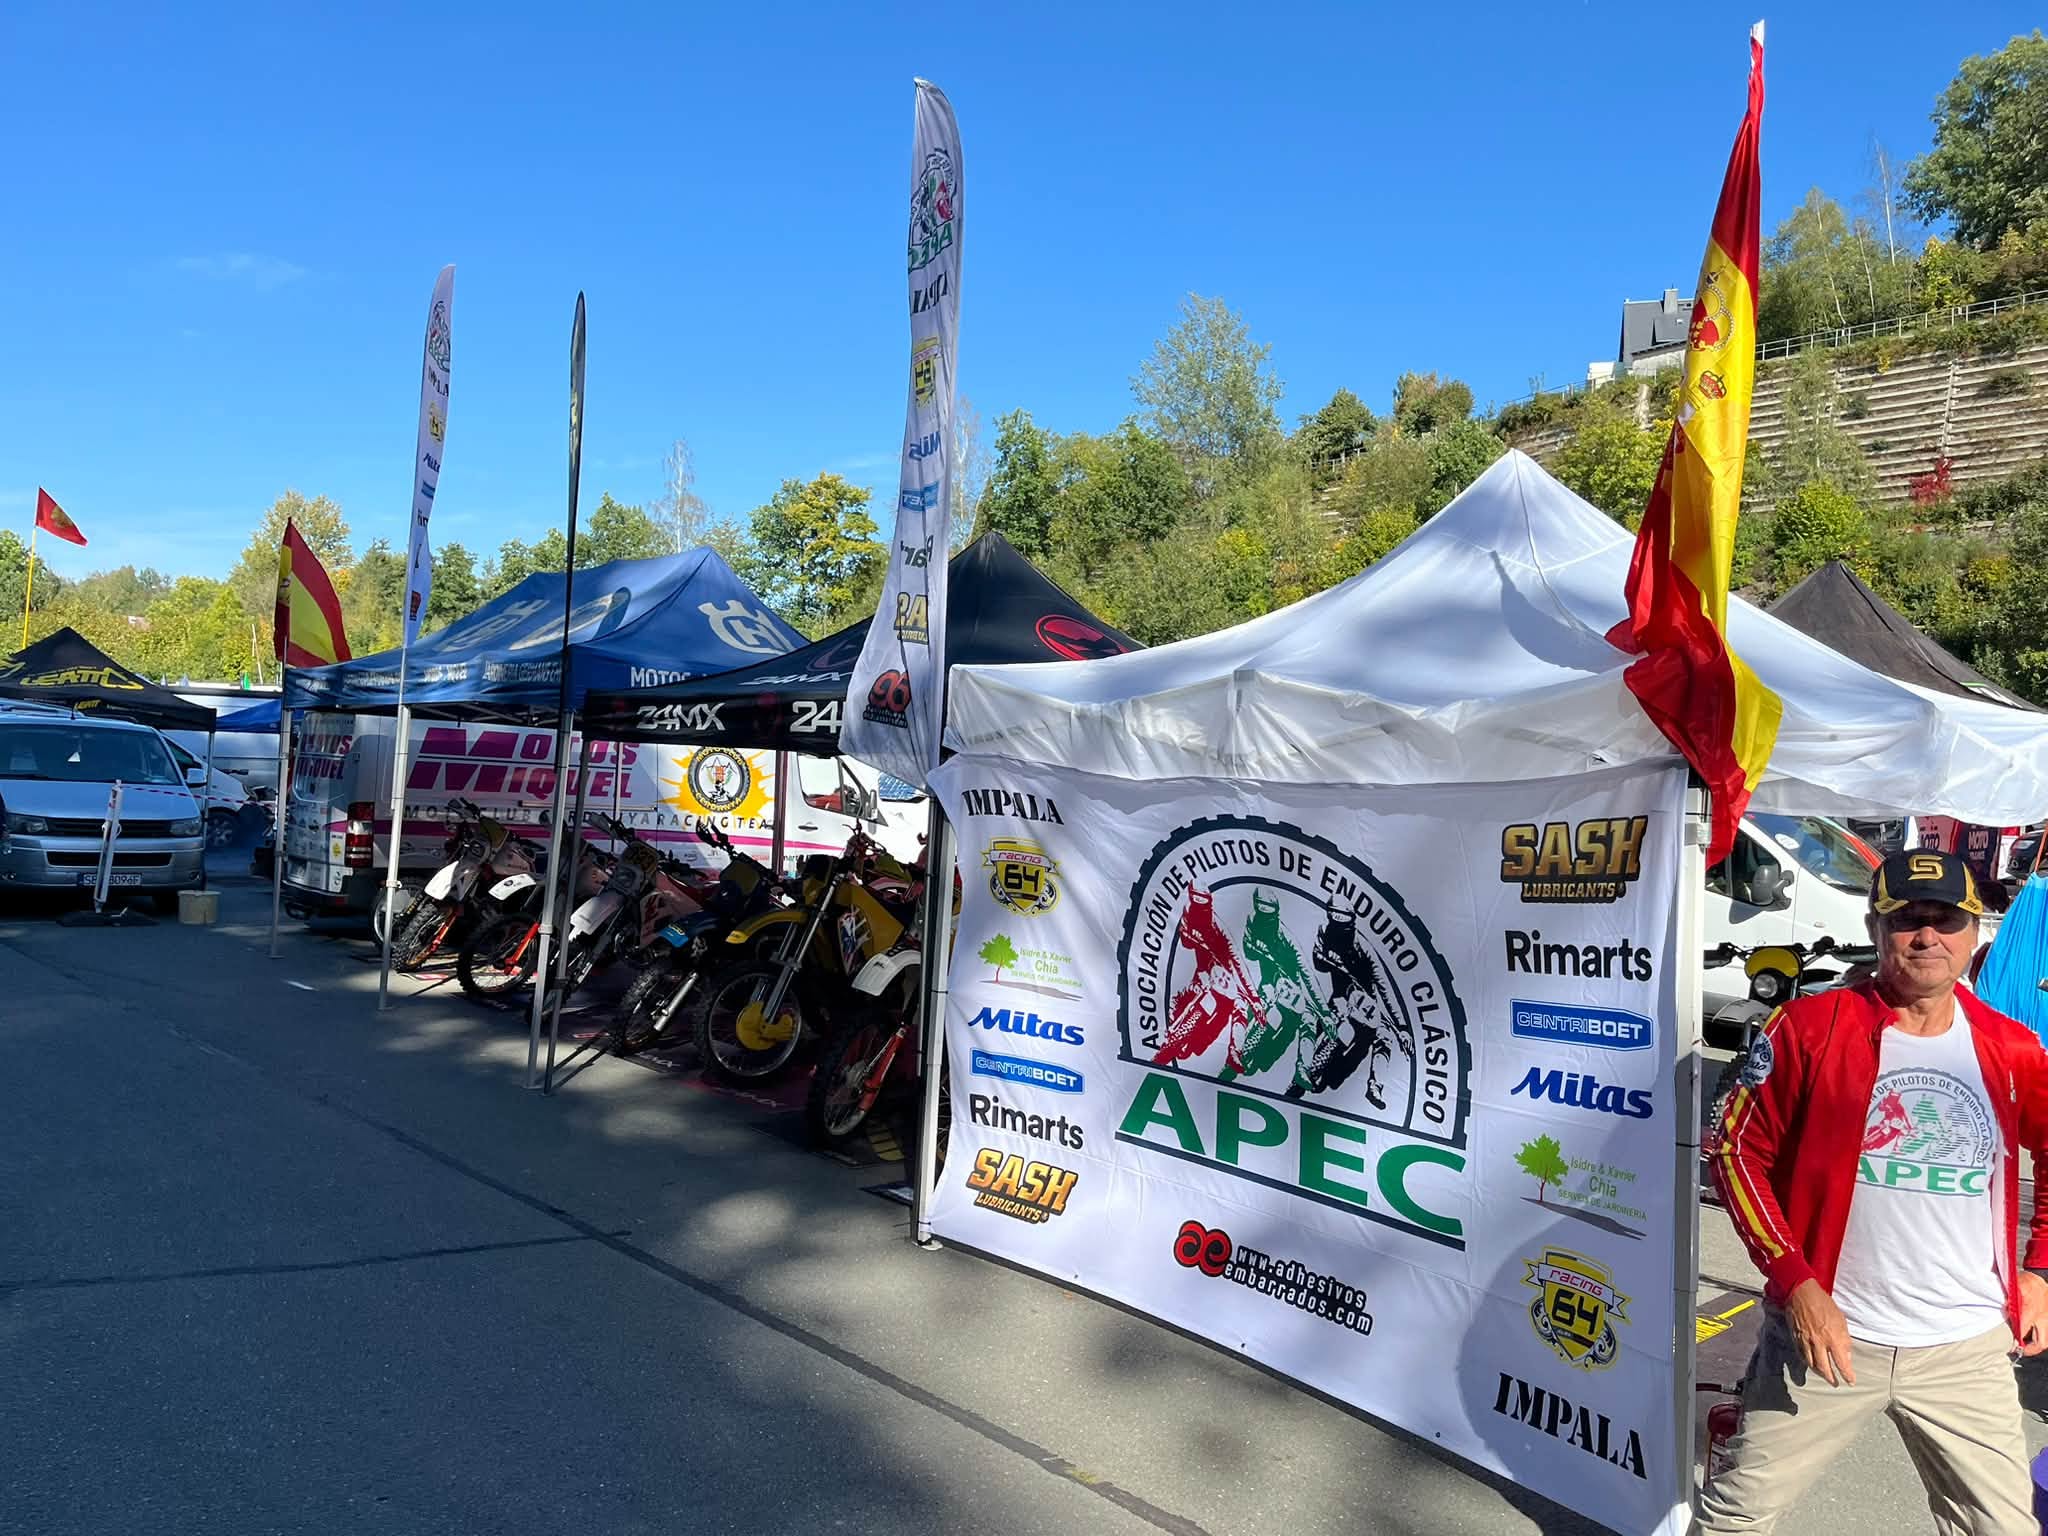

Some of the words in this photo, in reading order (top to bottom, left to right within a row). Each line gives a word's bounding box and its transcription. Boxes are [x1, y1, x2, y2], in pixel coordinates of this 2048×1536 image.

[636, 702, 726, 731] 24MX
[790, 701, 844, 733] 24
[738, 817, 770, 830] TEA
[962, 789, 1064, 825] IMPALA
[997, 851, 1042, 865] racing
[1501, 816, 1648, 881] SASH
[1969, 831, 1989, 849] MOTO
[1004, 864, 1040, 892] 64
[1522, 882, 1616, 900] LUBRICANTS
[1035, 960, 1058, 975] Chia
[1505, 930, 1652, 982] Rimarts
[1138, 892, 1173, 1050] ASOCIACIÓN
[1161, 866, 1190, 900] DE
[1183, 839, 1270, 879] PILOTOS
[1279, 846, 1312, 881] DE
[1320, 866, 1418, 971] ENDURO
[1410, 980, 1450, 1124] CLÁSICO
[968, 1007, 1085, 1046] Mitas
[1517, 1011, 1643, 1040] CENTRIBOET
[976, 1056, 1077, 1088] CENTRIBOET
[1510, 1067, 1653, 1119] Mitas
[1876, 1082, 1891, 1096] DE
[1893, 1075, 1936, 1089] PILOTOS
[1938, 1079, 1952, 1091] DE
[1954, 1086, 1982, 1120] ENDURO
[969, 1093, 1084, 1150] Rimarts
[1119, 1072, 1466, 1236] APEC
[1570, 1157, 1596, 1172] Isidre
[966, 1148, 1079, 1216] SASH
[1589, 1175, 1616, 1198] Chia
[1858, 1156, 1986, 1194] APEC
[975, 1191, 1043, 1222] LUBRICANTS
[1237, 1246, 1366, 1310] www.adhesivos
[1550, 1270, 1603, 1297] racing
[1224, 1262, 1373, 1335] embarrados.com
[1552, 1289, 1599, 1336] 64
[1494, 1372, 1648, 1480] IMPALA
